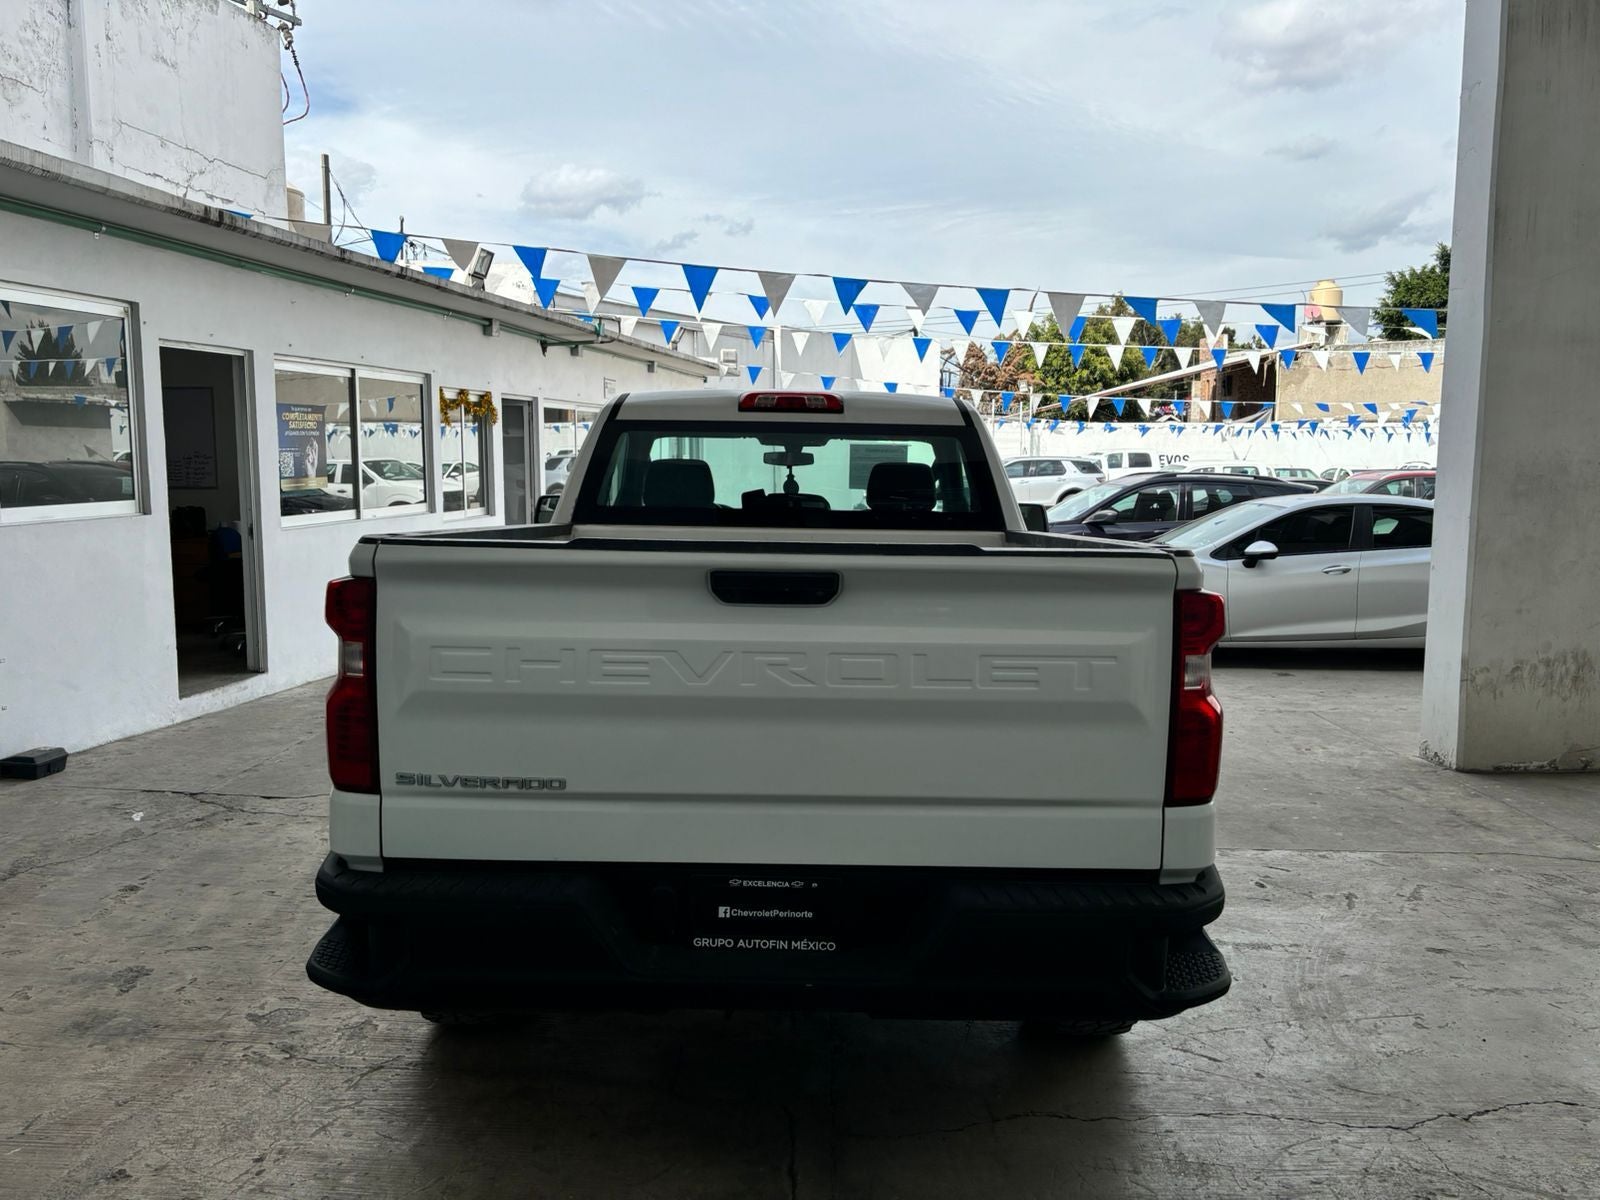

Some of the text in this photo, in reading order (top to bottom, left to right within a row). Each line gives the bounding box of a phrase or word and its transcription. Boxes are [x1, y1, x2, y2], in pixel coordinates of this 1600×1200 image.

[428, 645, 1118, 691] CHEVROLET
[395, 772, 567, 791] SILVERADO
[742, 880, 790, 888] EXCELENCIA
[731, 908, 813, 919] ChevroletPerinorte
[693, 937, 836, 951] GRUPO AUTOFIN MÉXICO
